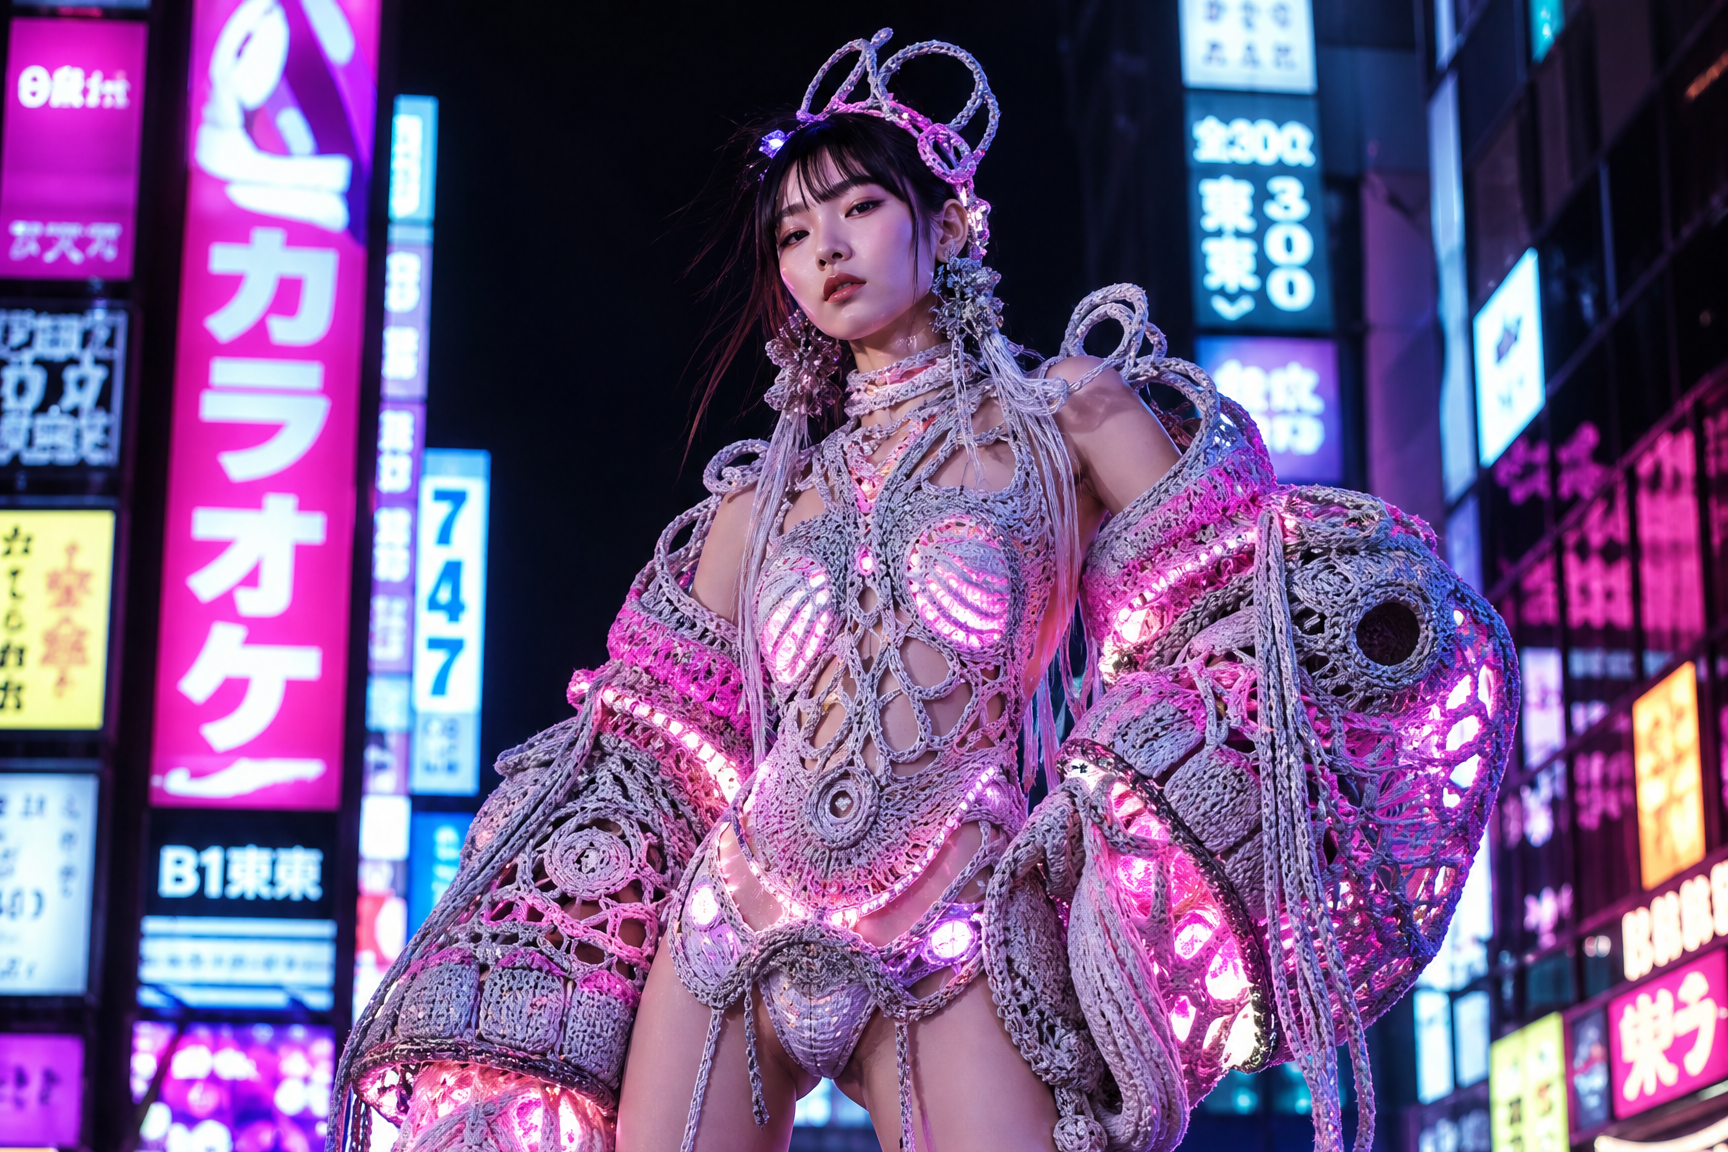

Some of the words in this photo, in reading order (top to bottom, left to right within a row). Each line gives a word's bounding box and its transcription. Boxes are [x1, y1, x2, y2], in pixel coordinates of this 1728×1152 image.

[177, 227, 339, 753] カラオケ
[427, 490, 467, 696] 747
